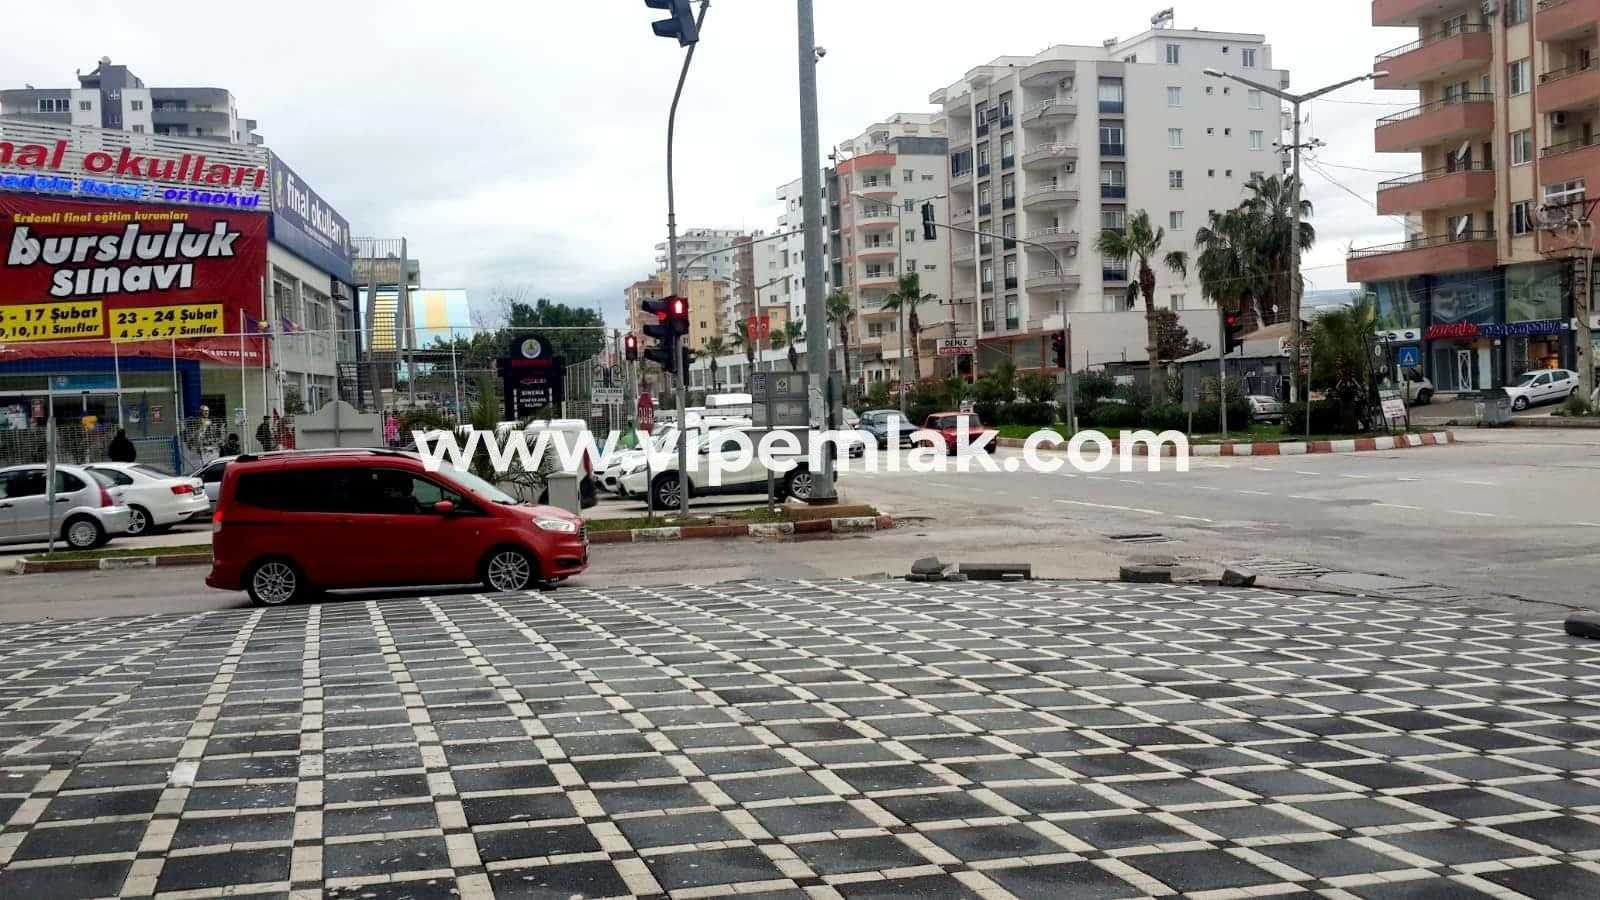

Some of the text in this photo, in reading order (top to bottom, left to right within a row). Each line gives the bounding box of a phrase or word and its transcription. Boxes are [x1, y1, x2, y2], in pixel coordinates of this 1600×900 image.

[84, 147, 265, 188] okulları
[164, 188, 260, 207] ortaokul
[287, 173, 310, 222] final
[14, 210, 188, 223] Erdemli final eğitim kurumları
[8, 222, 241, 265] bursluluk
[50, 263, 193, 296] sınavı
[25, 308, 45, 321] 17
[51, 306, 98, 323] Şubat
[117, 312, 137, 324] 23
[154, 310, 175, 322] 24
[180, 308, 218, 324] Şubat
[52, 321, 98, 334] Sınıflar
[180, 323, 218, 335] Sınıflar
